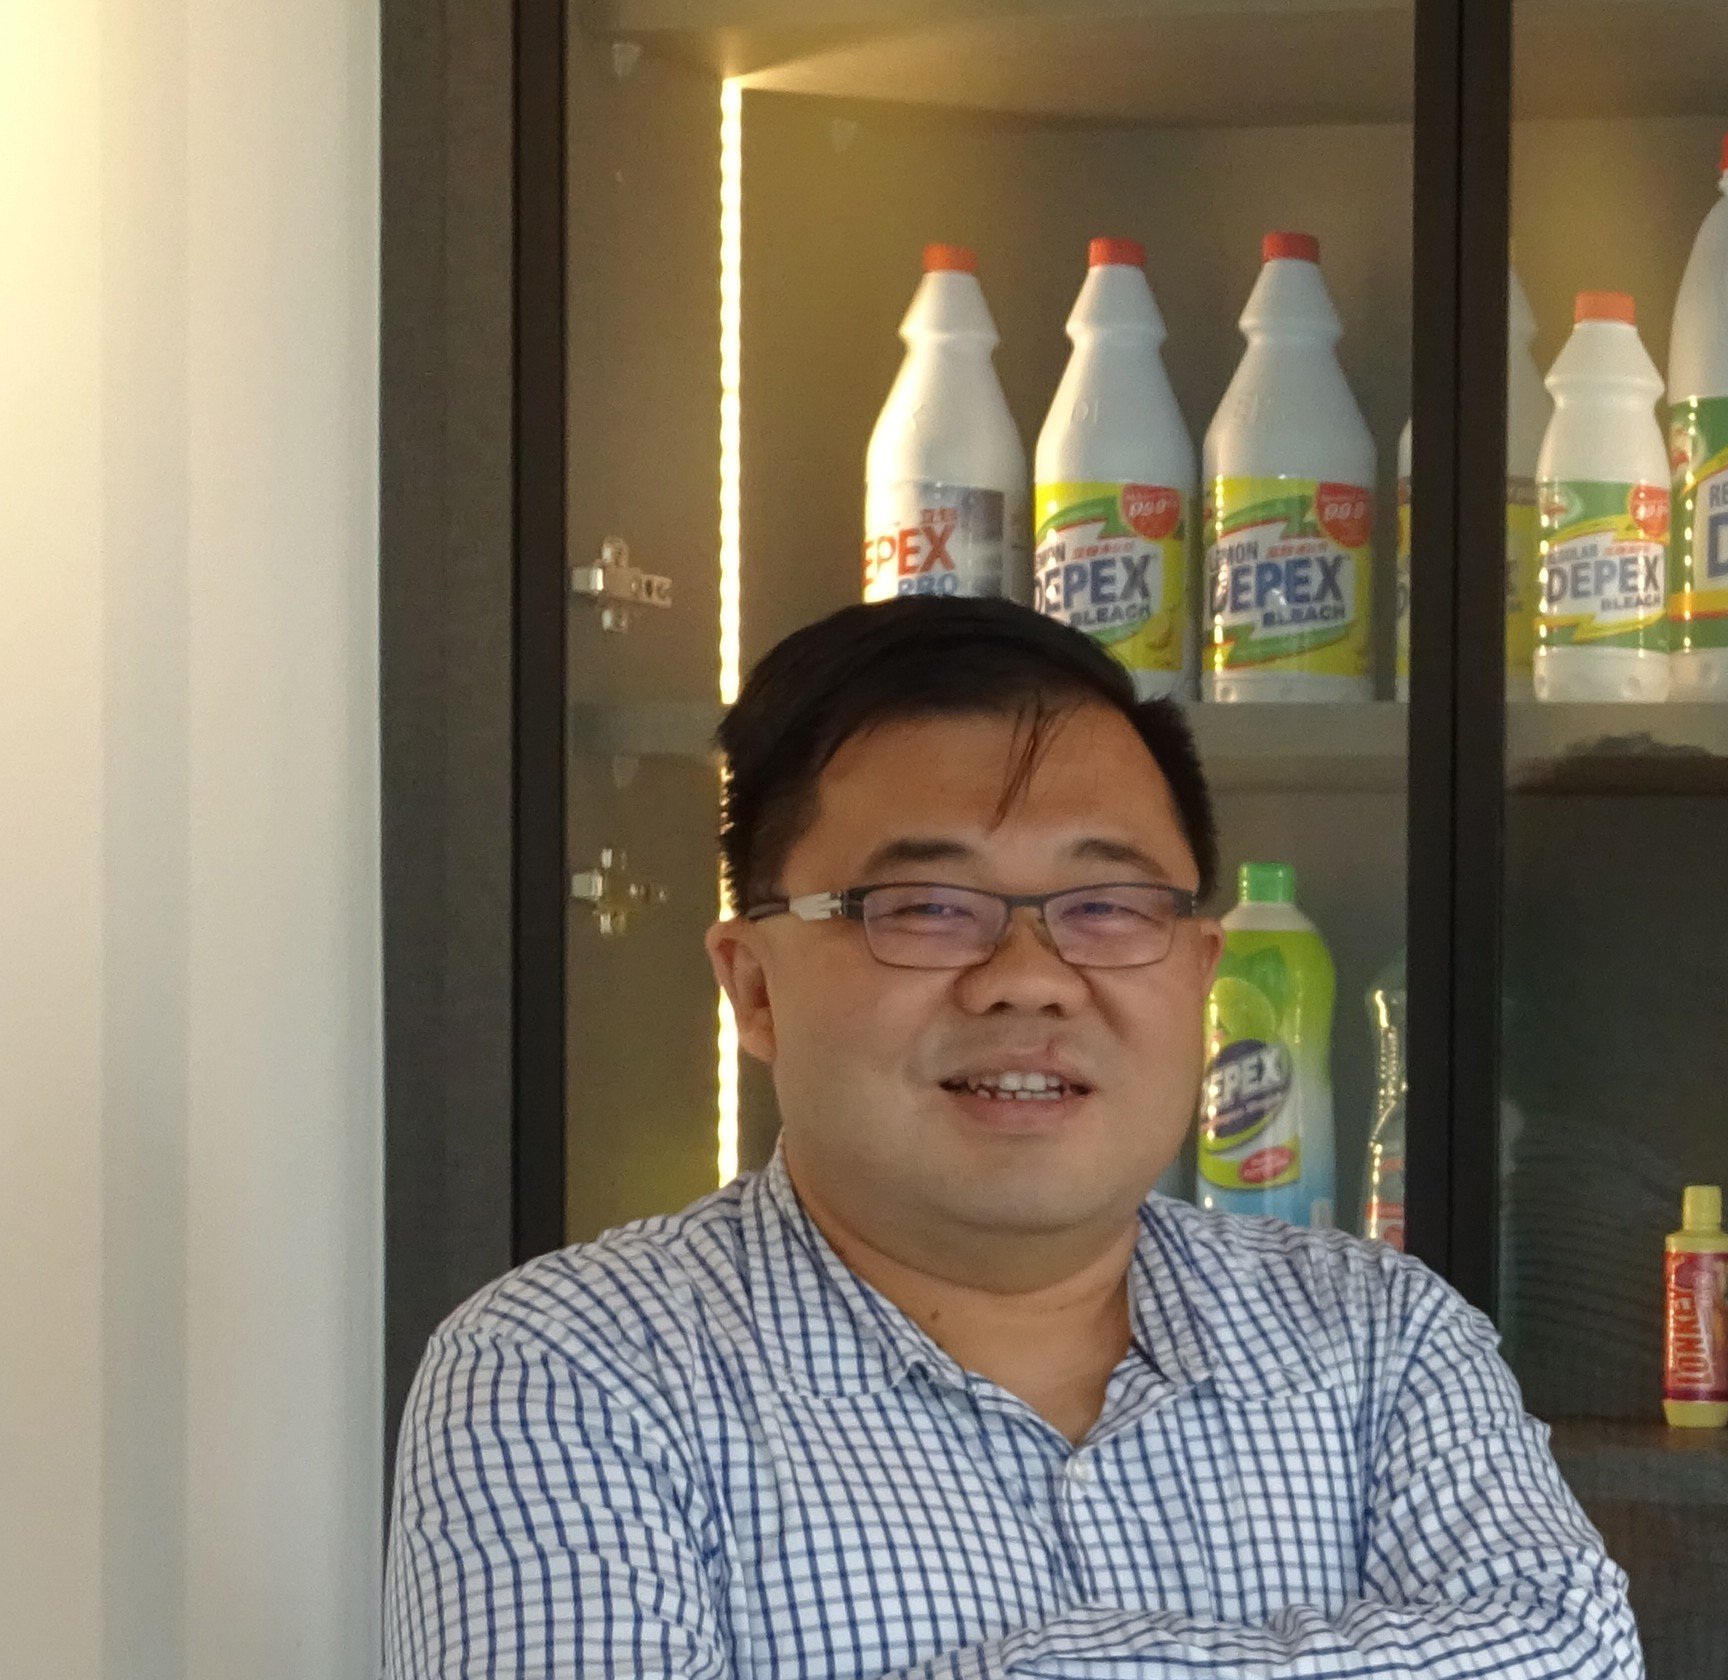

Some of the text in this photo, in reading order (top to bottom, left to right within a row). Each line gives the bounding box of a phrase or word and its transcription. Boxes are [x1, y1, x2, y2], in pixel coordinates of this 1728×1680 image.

[1210, 555, 1345, 616] DEPEX
[1547, 555, 1660, 603] DEPEX
[1262, 604, 1346, 628] BLEACH
